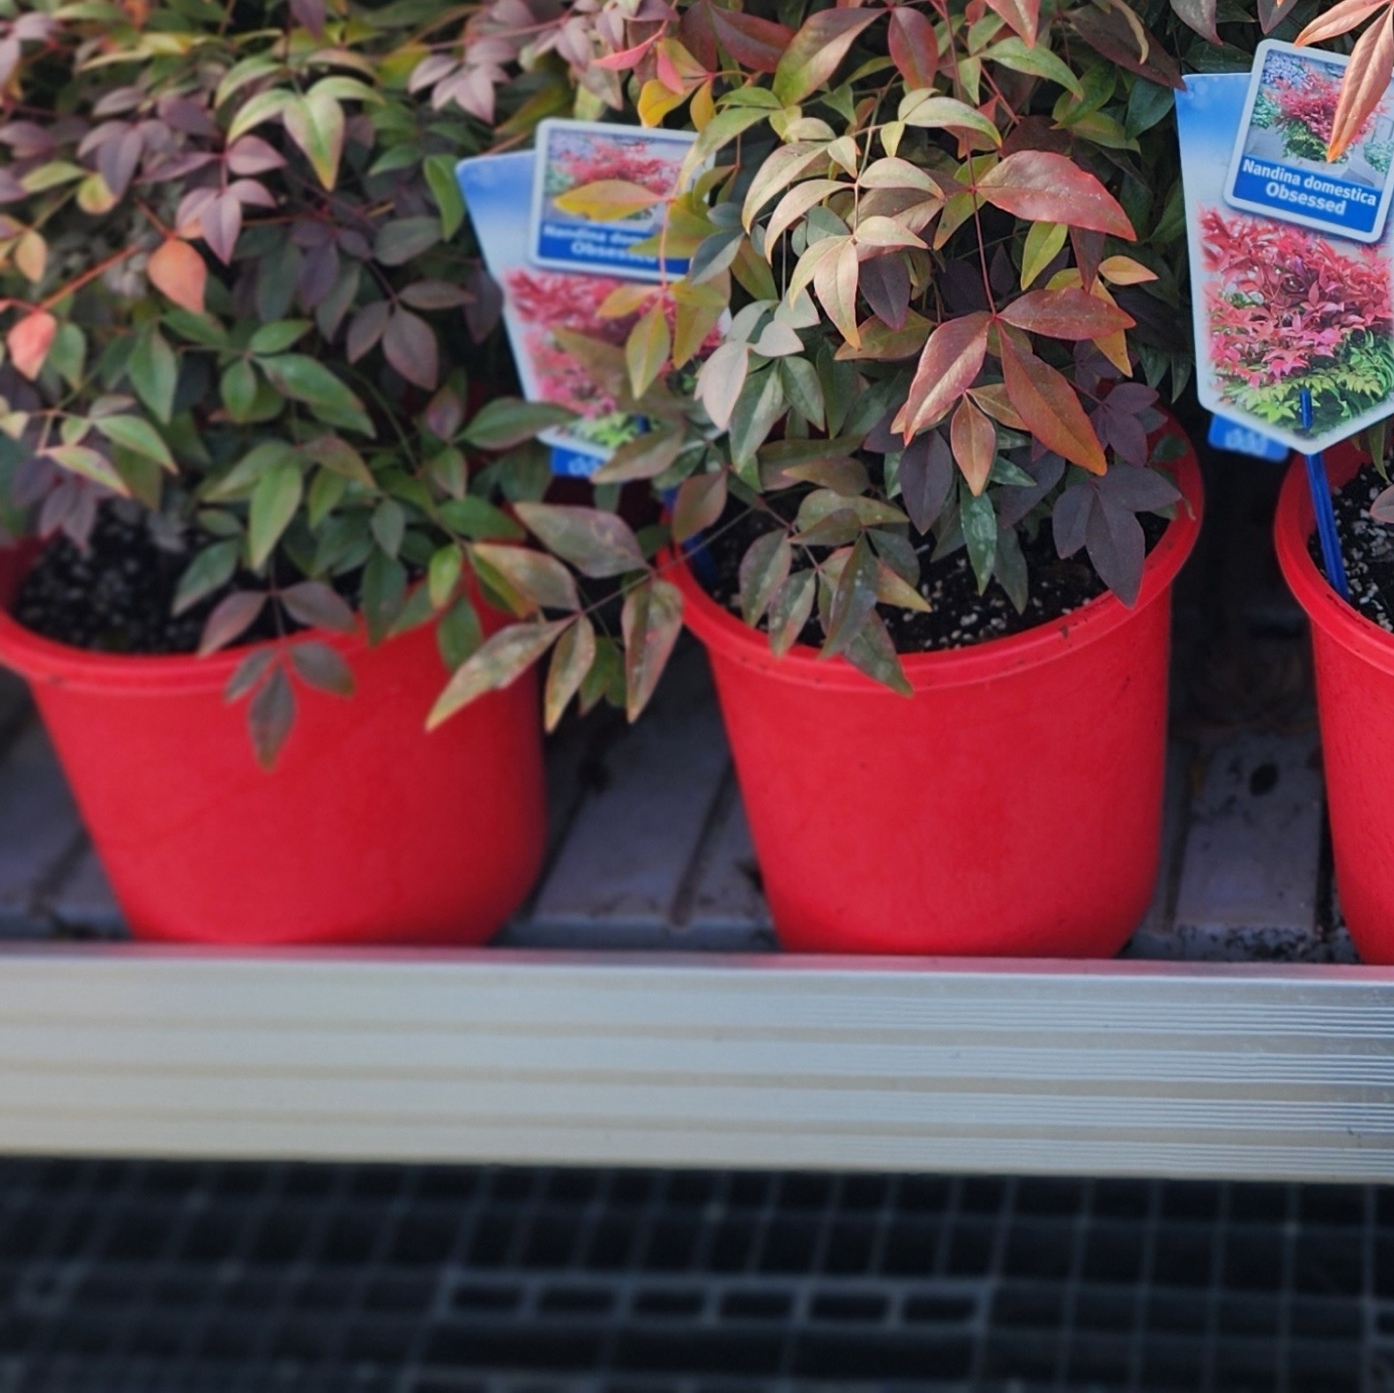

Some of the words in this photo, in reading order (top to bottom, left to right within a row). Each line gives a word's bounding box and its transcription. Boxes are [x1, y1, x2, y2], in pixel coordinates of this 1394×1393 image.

[1243, 159, 1301, 186] Nandina
[1304, 176, 1377, 206] domestica
[1266, 182, 1347, 215] Obsessed
